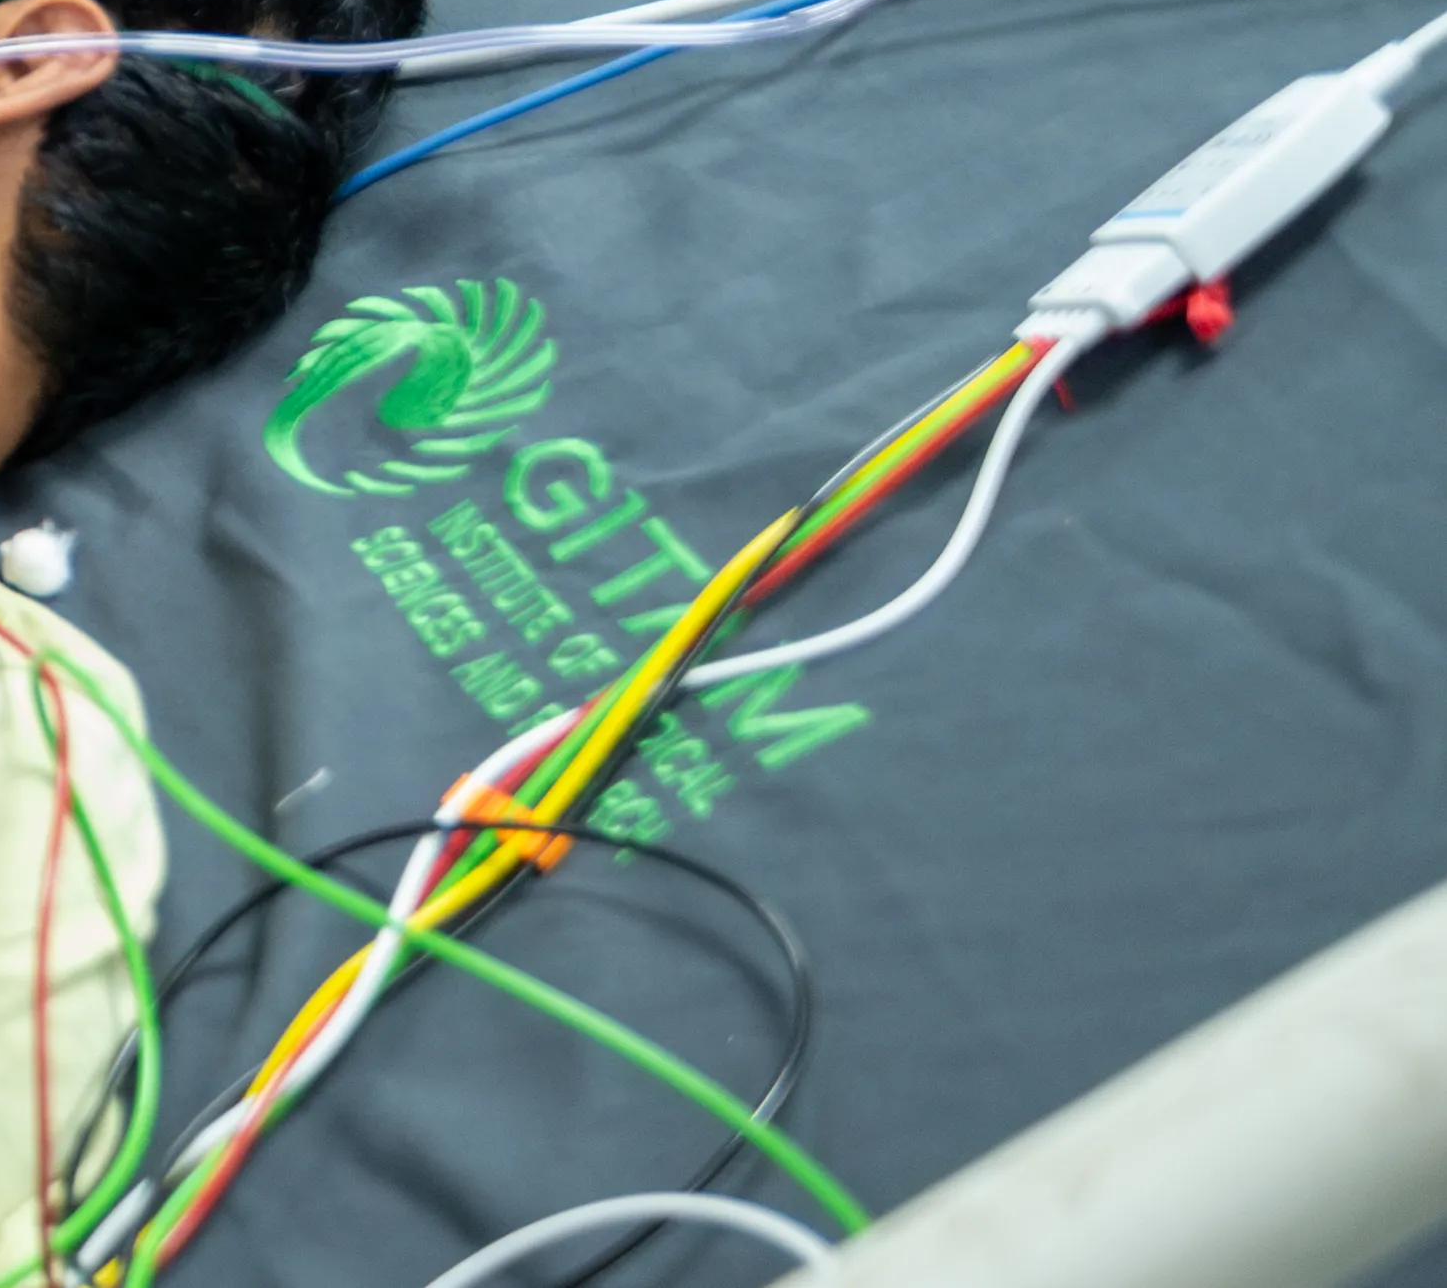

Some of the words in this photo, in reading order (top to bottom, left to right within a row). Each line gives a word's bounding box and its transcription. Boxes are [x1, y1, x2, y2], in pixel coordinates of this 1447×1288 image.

[349, 525, 488, 659] SCIENCES
[449, 652, 547, 720] AND
[427, 498, 575, 644] INSTITUTE
[547, 631, 620, 680] OF
